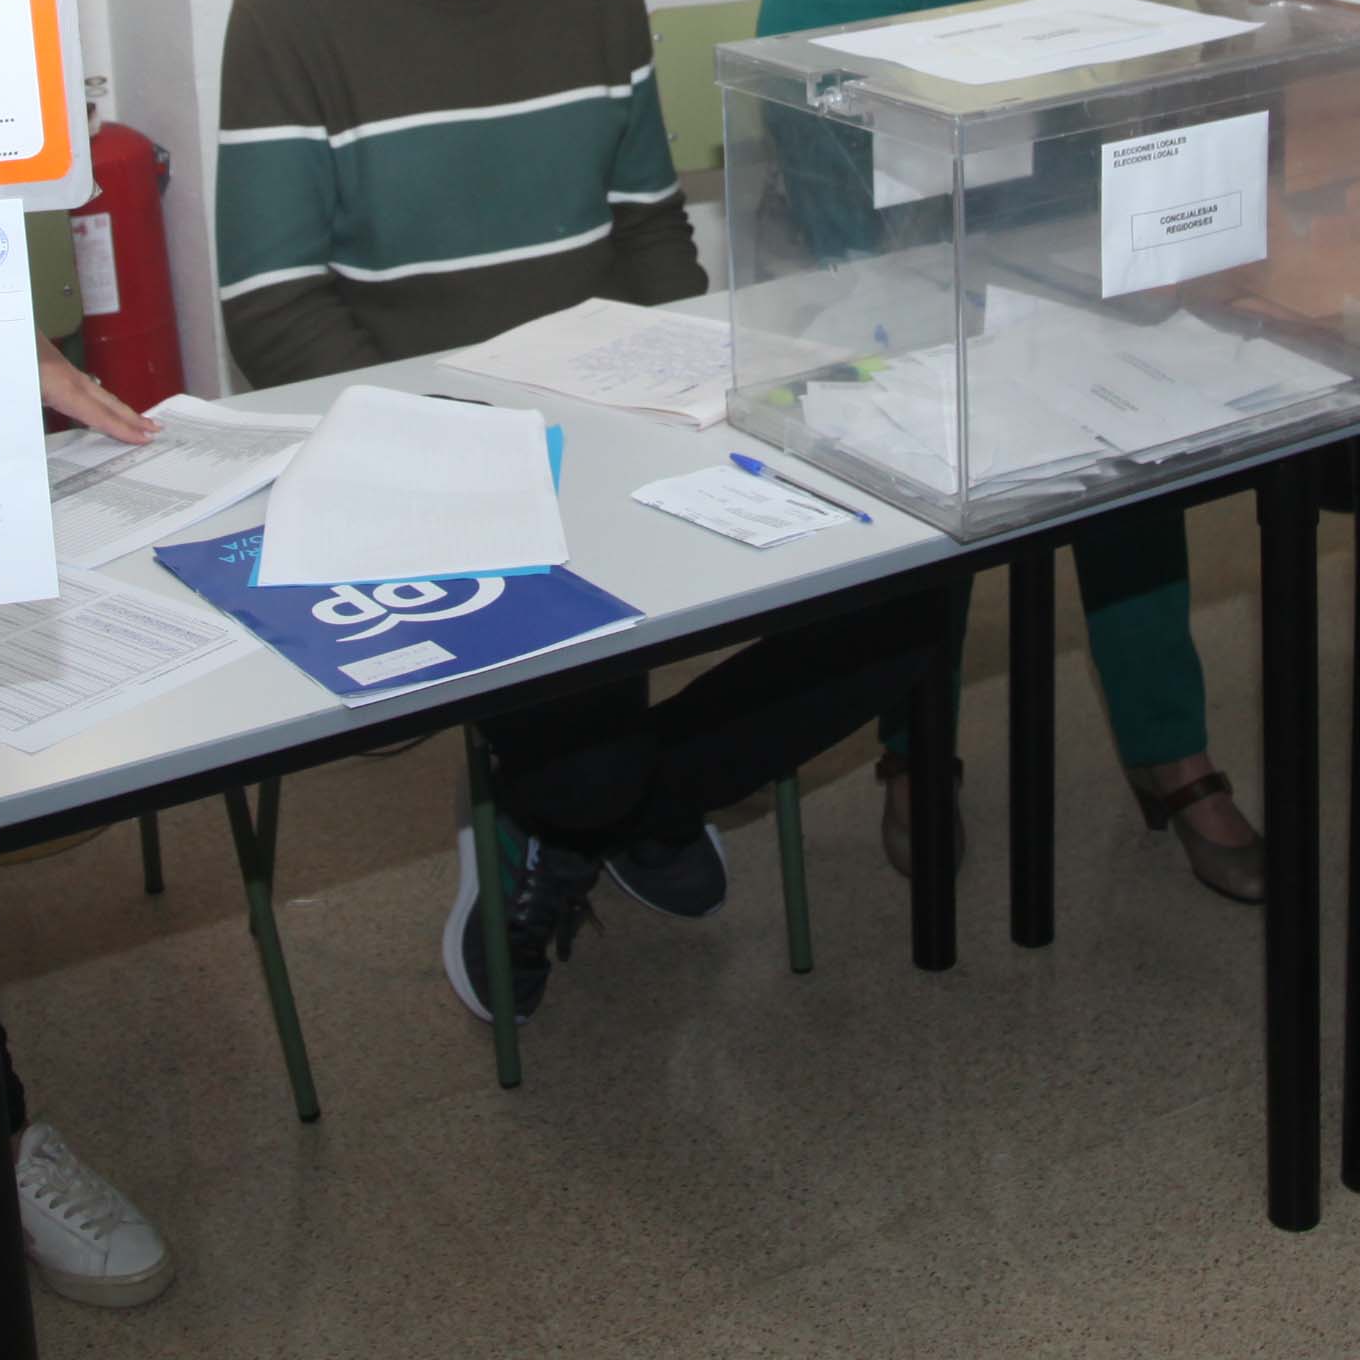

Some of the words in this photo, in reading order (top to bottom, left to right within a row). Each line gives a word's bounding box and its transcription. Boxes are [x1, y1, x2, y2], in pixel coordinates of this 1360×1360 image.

[1113, 144, 1156, 159] ELECCIONES
[1157, 136, 1188, 149] LOCALES
[1113, 154, 1152, 169] ELECCIONS
[1153, 148, 1179, 161] LOCALS
